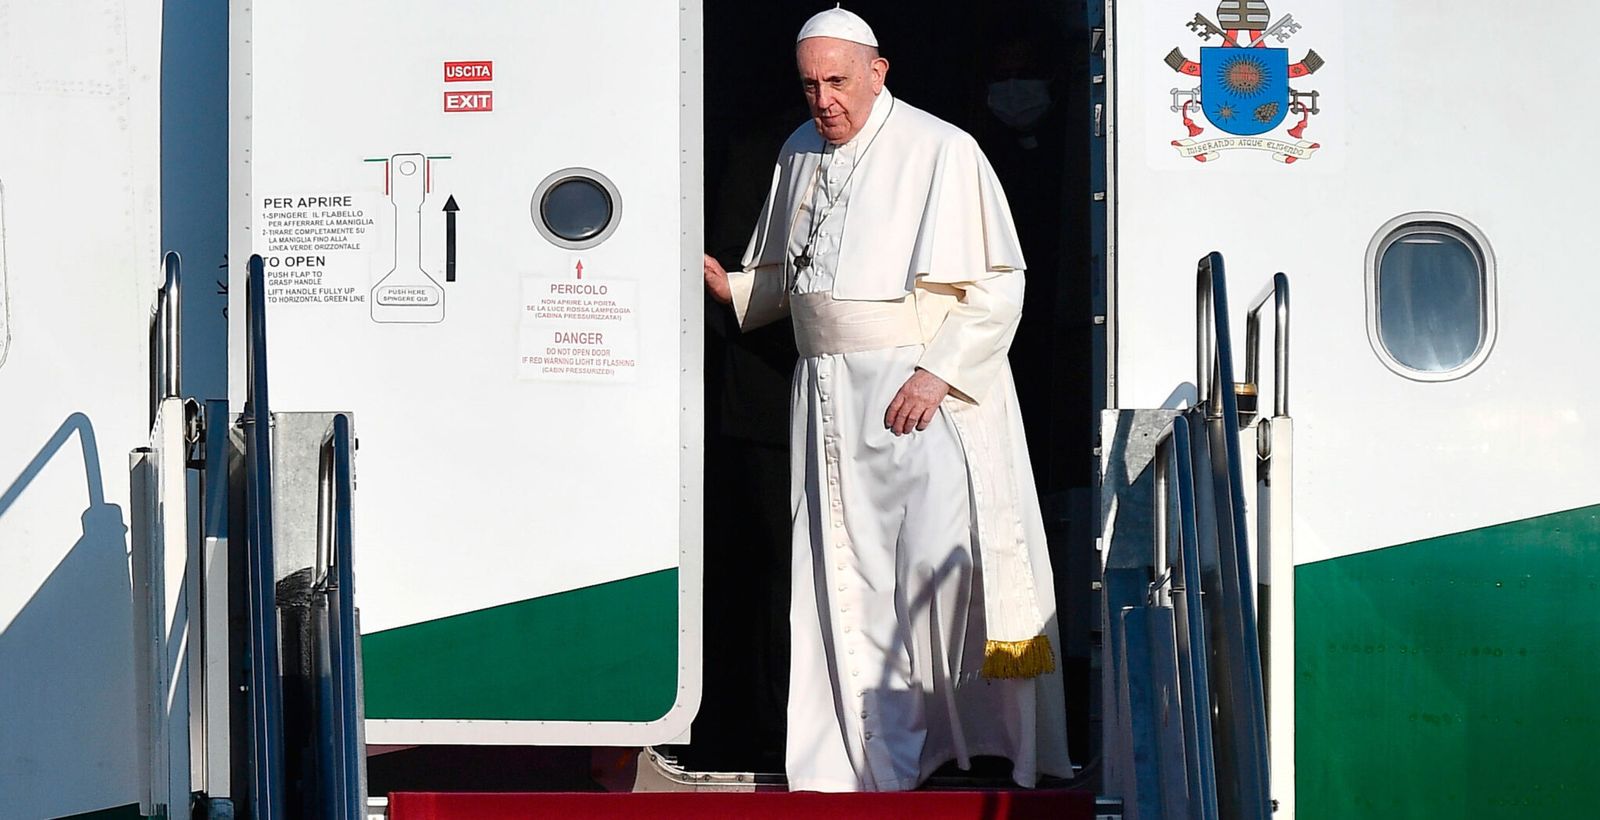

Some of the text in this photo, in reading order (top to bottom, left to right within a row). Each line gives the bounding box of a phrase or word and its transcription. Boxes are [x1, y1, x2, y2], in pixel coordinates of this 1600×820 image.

[446, 66, 490, 77] USCITA
[447, 95, 490, 108] EXIT
[264, 196, 352, 208] PER APRIRE
[264, 256, 325, 267] TO OPEN
[550, 284, 607, 295] PERICOLO
[555, 332, 603, 344] DANGER
